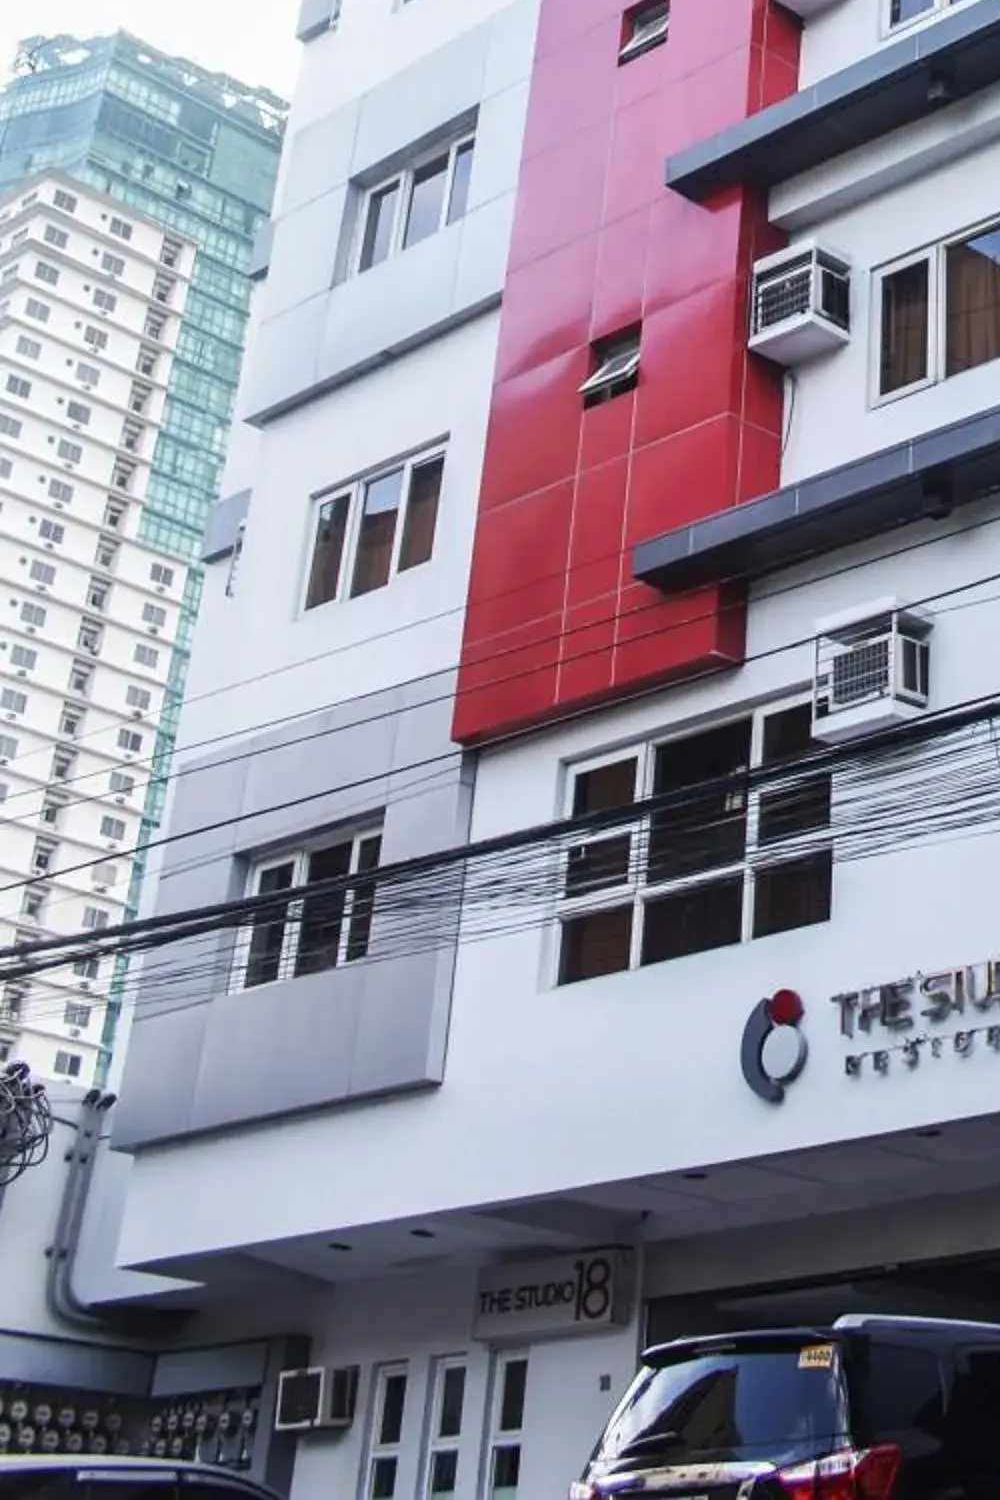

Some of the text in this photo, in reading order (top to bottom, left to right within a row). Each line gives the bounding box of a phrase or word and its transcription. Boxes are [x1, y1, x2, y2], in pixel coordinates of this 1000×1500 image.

[831, 978, 914, 1039] THE
[480, 1257, 611, 1322] THE STUDIO 18
